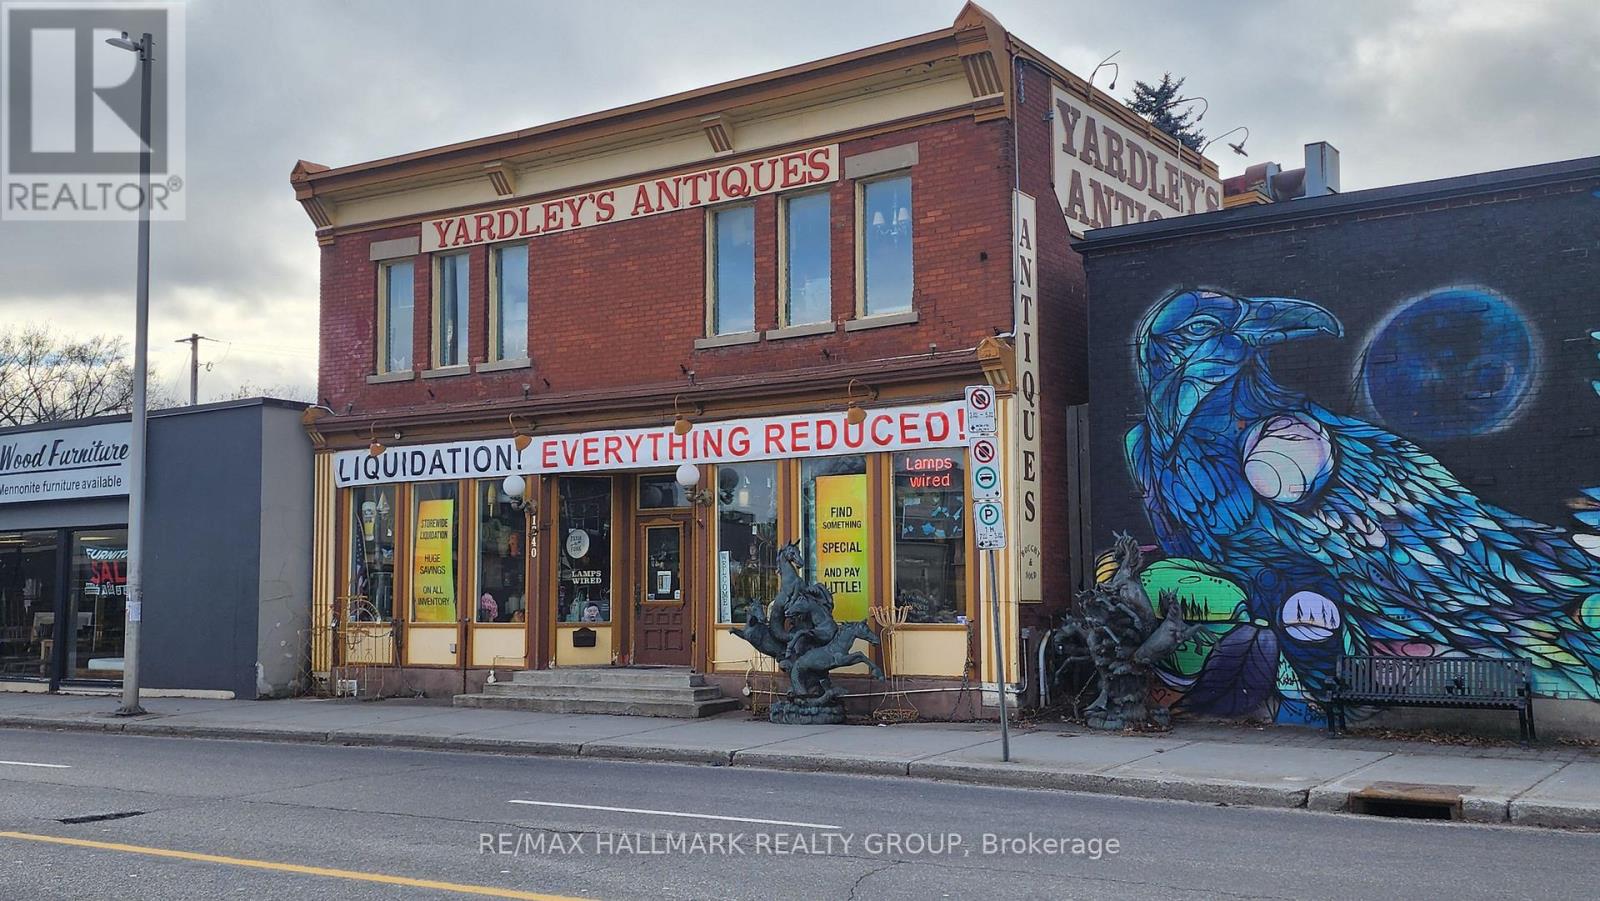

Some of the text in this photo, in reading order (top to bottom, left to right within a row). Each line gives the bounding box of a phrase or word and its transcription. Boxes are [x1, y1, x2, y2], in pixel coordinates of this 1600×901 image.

[1056, 98, 1219, 214] YARDLEY'S
[433, 148, 830, 248] YARDLEY'S ANTIQUES
[1019, 218, 1036, 521] ANTIQUES
[339, 408, 966, 482] LIQUIDATION! EVERYTHING REDUCED!
[0, 439, 129, 471] Wood Furniture
[906, 457, 952, 470] Lamps
[42, 479, 80, 492] furniture
[81, 475, 122, 489] available
[909, 473, 950, 488] wired
[831, 506, 852, 518] FIND
[984, 509, 993, 520] P
[421, 518, 448, 528] STOREWIDE
[822, 520, 862, 529] SOMETHING
[420, 530, 448, 540] LIQUIDATION
[822, 541, 862, 553] SPECIAL
[86, 548, 128, 560] FURNITU
[424, 553, 441, 563] HUGE
[89, 560, 127, 584] SAL
[420, 565, 446, 575] SAVINGS
[572, 570, 602, 578] LAMPS
[824, 567, 860, 577] AND PAY
[423, 586, 443, 594] ON ALL
[418, 597, 450, 606] INVENTORY
